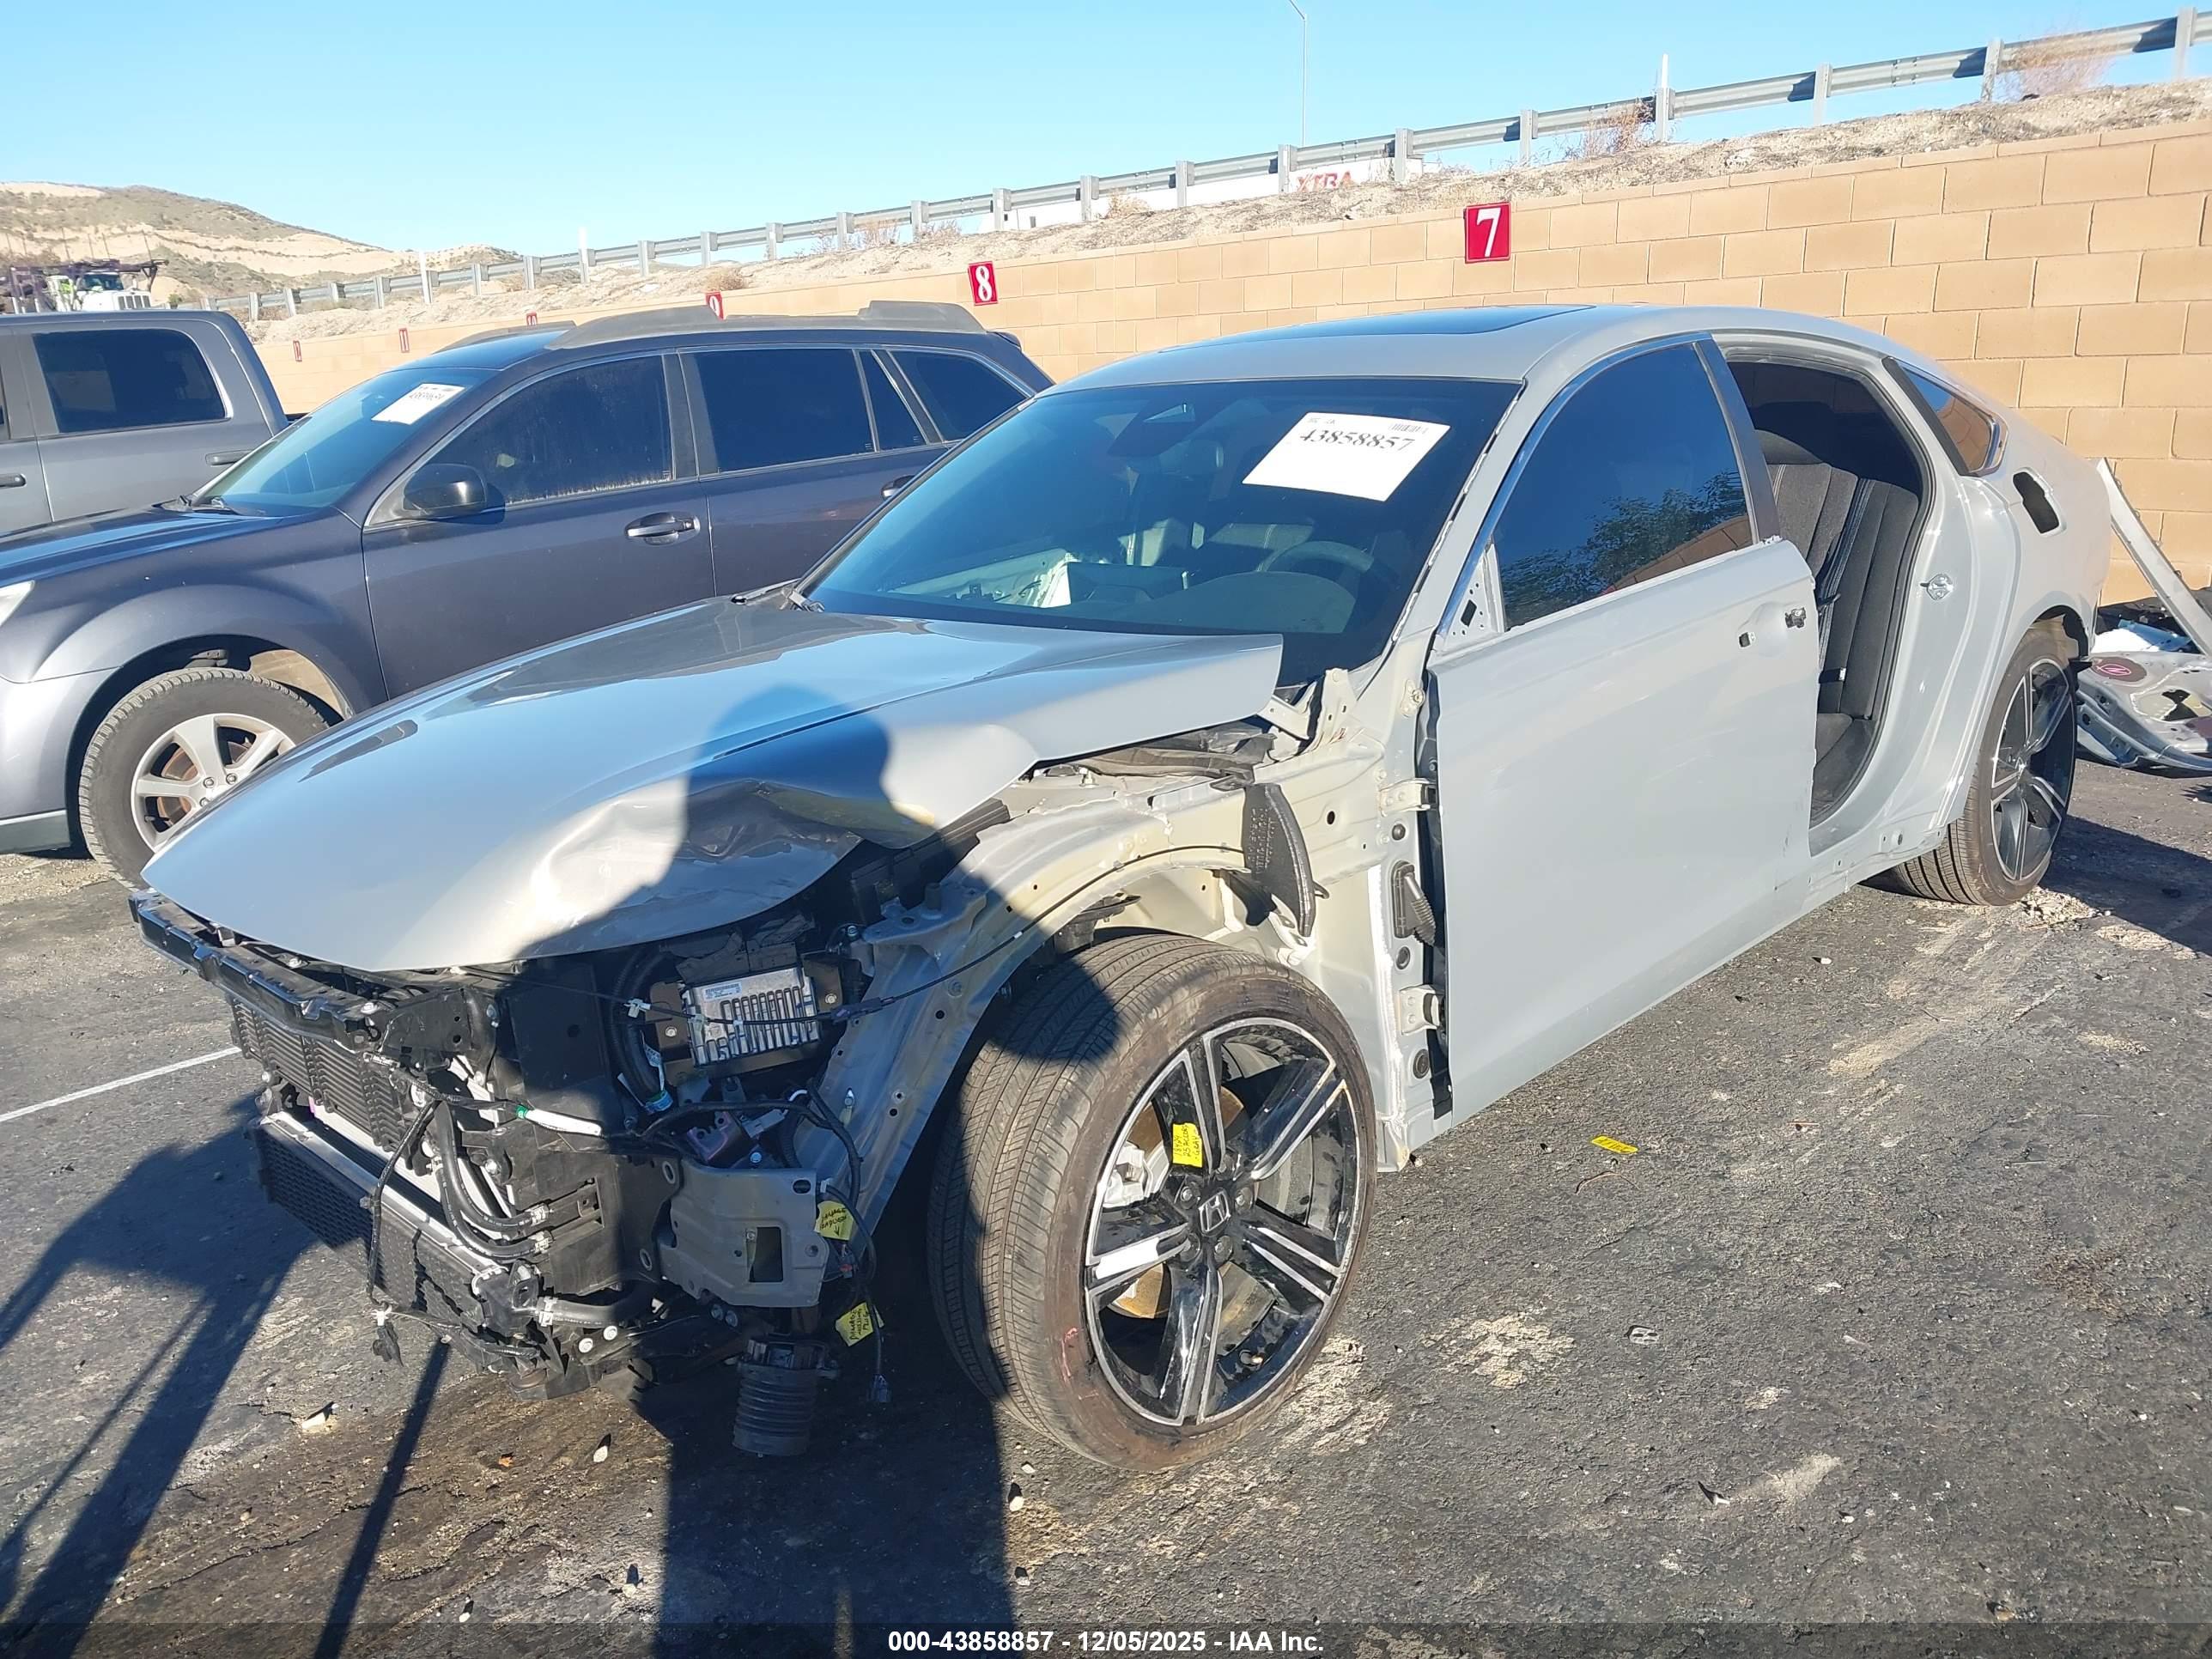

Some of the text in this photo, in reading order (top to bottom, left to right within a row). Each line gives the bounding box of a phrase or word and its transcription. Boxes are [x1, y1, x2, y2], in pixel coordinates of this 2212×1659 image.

[1476, 207, 1501, 258] 7
[975, 265, 992, 301] 8
[399, 330, 409, 351] 11
[1299, 428, 1416, 452] 43858857
